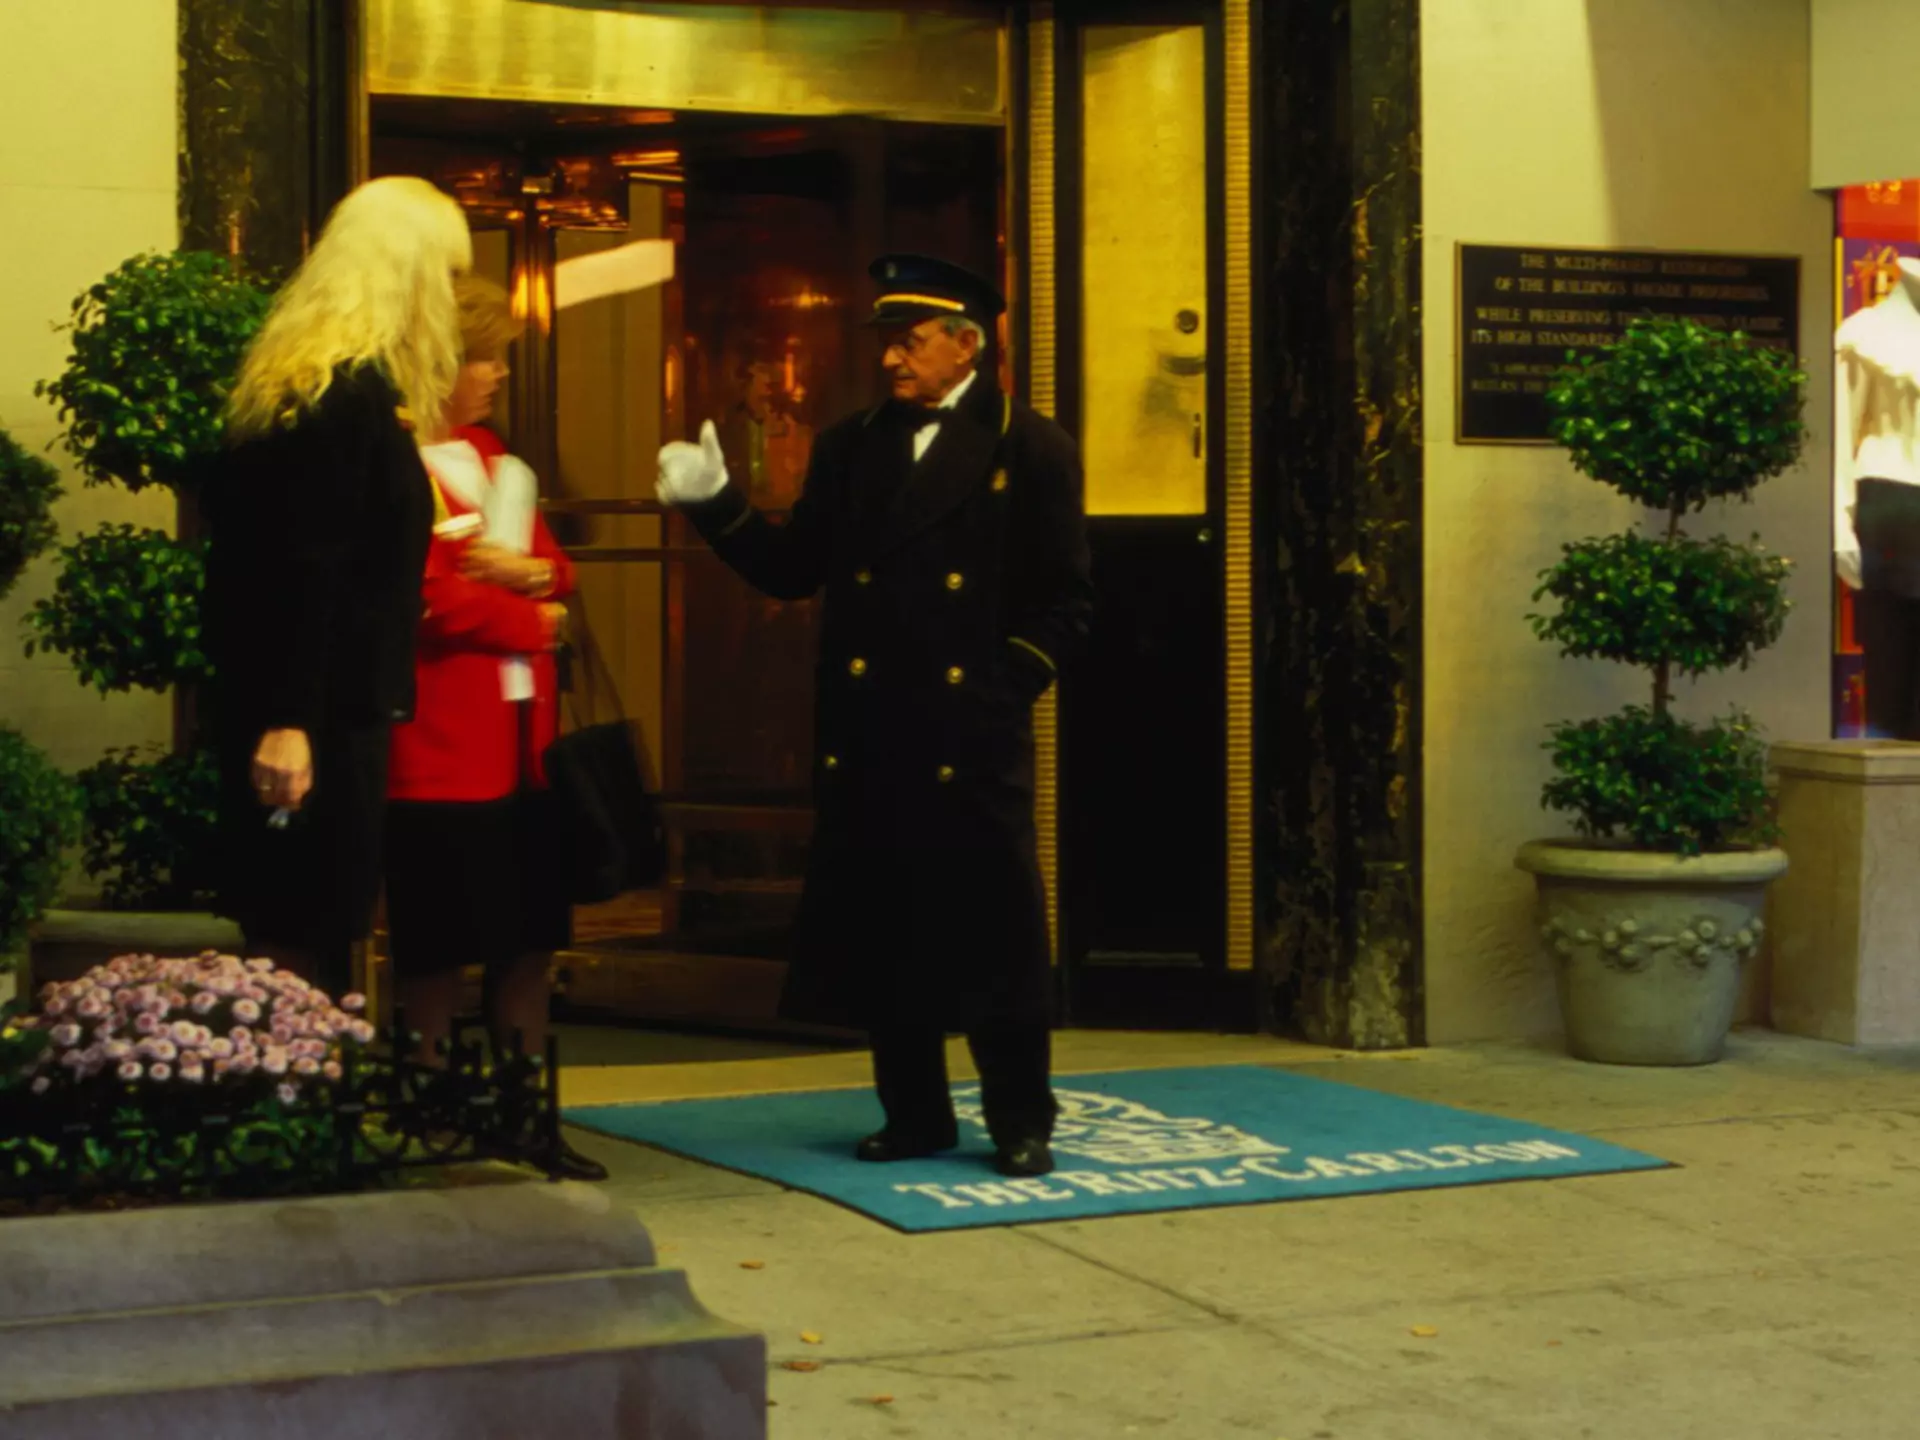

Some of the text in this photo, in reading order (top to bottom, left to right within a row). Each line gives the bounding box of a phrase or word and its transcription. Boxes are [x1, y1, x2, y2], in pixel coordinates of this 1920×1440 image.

[1520, 253, 1546, 269] THE
[1494, 276, 1514, 291] OF
[1518, 277, 1545, 293] THE
[1475, 306, 1522, 322] WHILE
[1529, 308, 1612, 325] PRESERVING
[1497, 330, 1533, 345] HIGH
[893, 1139, 1580, 1208] THE RITZ-CARLTON
